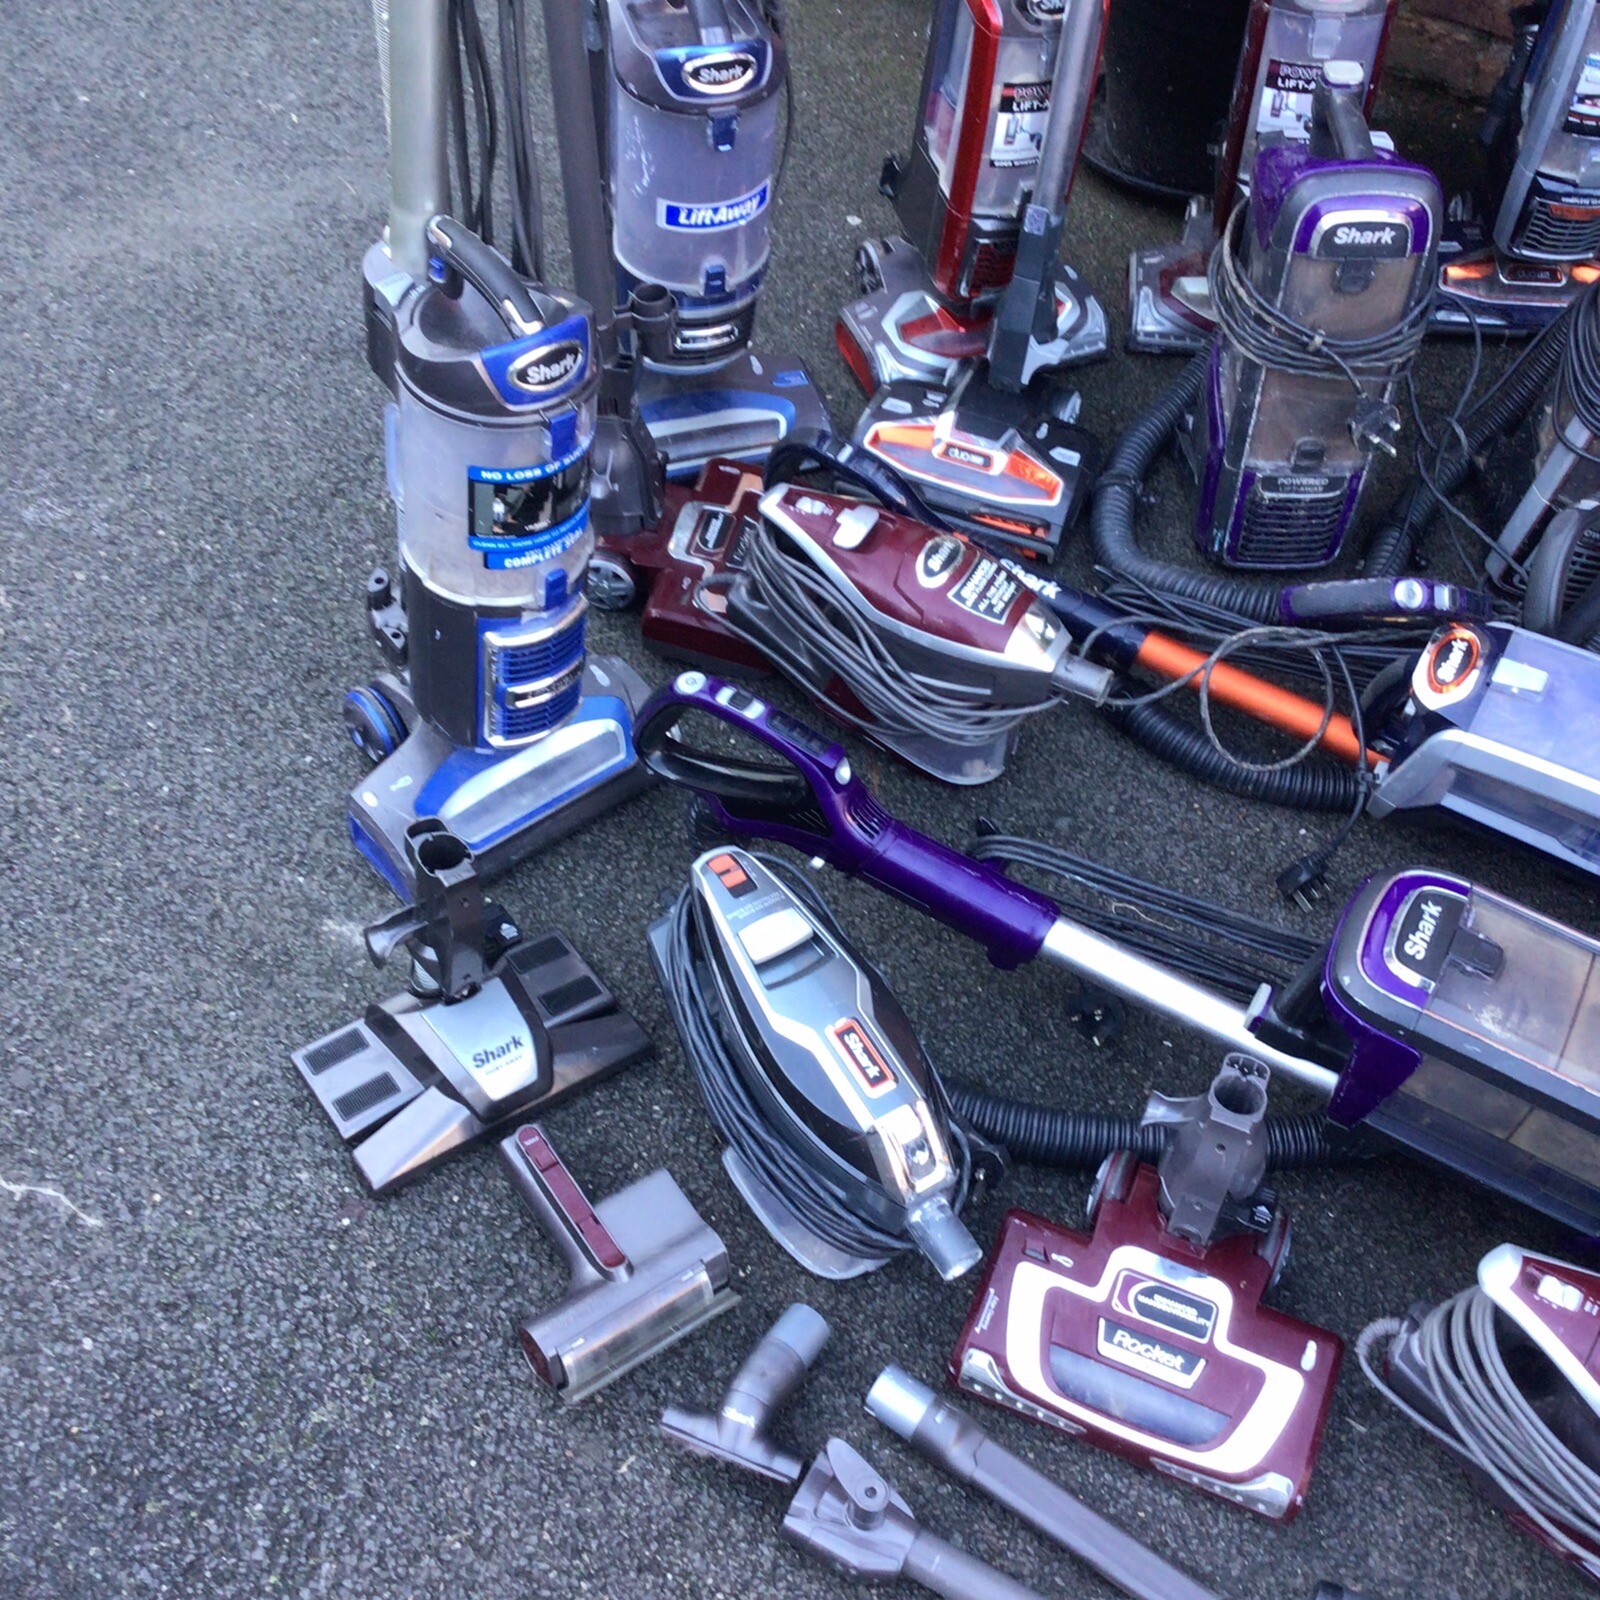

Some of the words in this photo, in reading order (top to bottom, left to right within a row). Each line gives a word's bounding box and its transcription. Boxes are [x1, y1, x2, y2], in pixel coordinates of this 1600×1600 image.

[698, 64, 744, 83] Shark
[1334, 226, 1396, 245] Shark
[525, 352, 576, 384] Shark
[481, 470, 502, 480] NO
[506, 468, 542, 480] LOSS
[545, 461, 561, 473] OF
[1278, 477, 1329, 486] POWERED
[927, 540, 955, 572] Shark
[1436, 638, 1469, 683] Shark
[1404, 900, 1442, 960] Shark
[472, 1035, 524, 1068] Shark
[843, 1032, 880, 1079] Shark
[1113, 1329, 1185, 1371] Rocket
